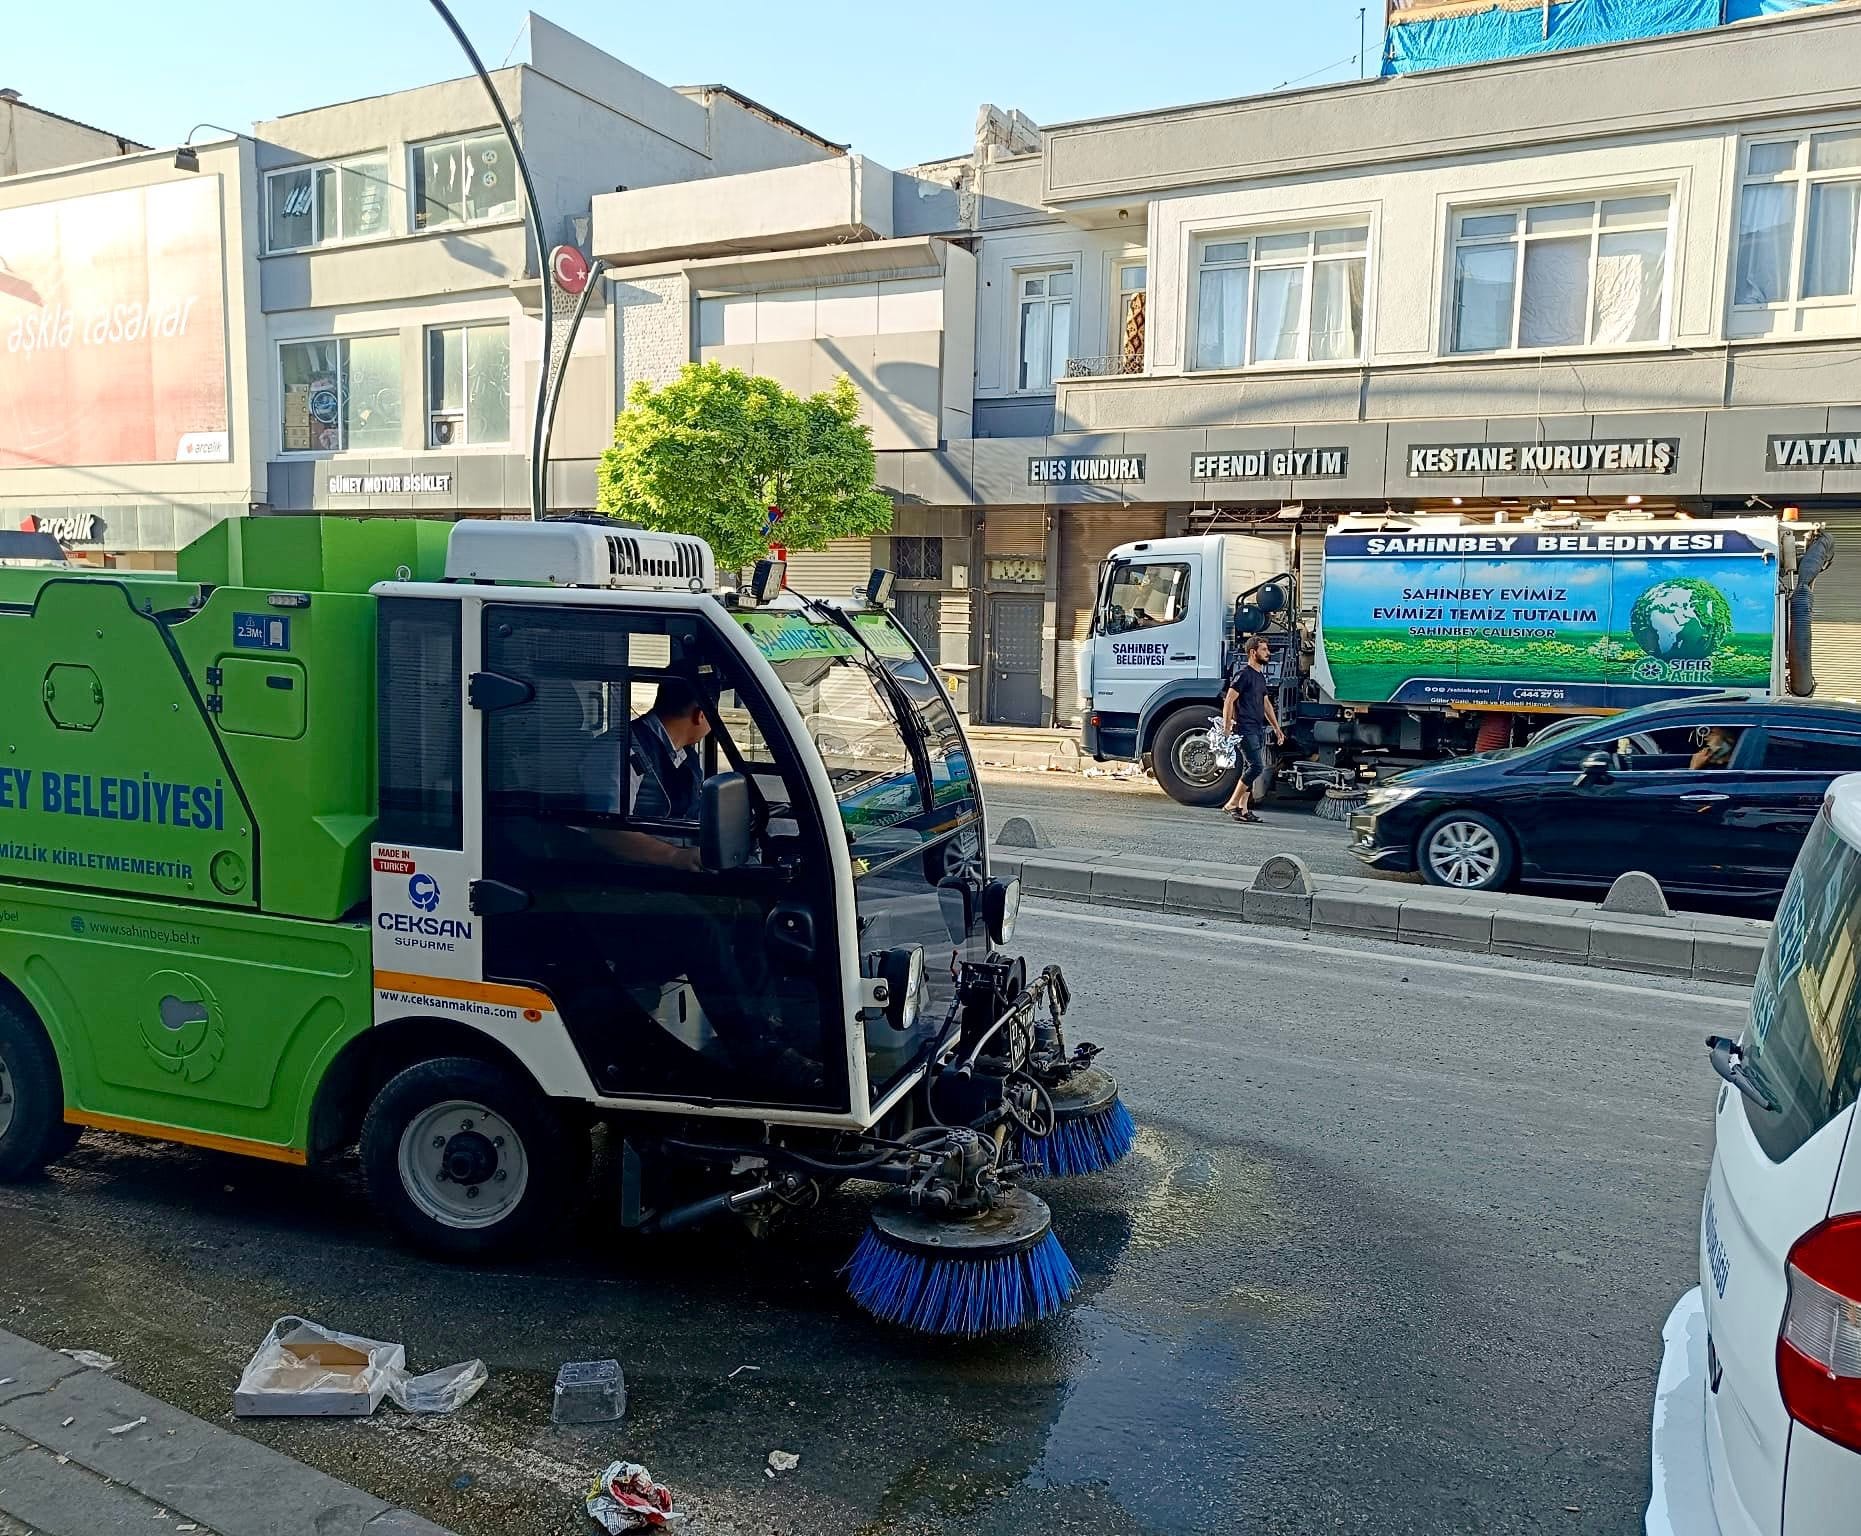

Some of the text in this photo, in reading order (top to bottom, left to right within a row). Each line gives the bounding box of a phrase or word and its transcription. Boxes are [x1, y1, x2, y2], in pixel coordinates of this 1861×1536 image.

[1194, 448, 1342, 477] EFENDİ GİYİM
[1411, 439, 1670, 473] KESTANE KURUYEMİŞ
[1774, 438, 1861, 465] VATAN
[1031, 458, 1140, 481] ENES KUNDURA
[329, 472, 450, 493] GÜNEY MOTOR BİSİKLET
[1500, 585, 1567, 601] EVİMİZ
[1449, 605, 1506, 621] TEMİZ
[1512, 608, 1597, 622] TUTALIM
[1670, 659, 1712, 671] SIFIR
[1520, 690, 1539, 698] 444
[42, 771, 224, 831] BELEDİYESİ
[52, 847, 193, 880] KİRLETMEMEKTİR
[378, 848, 410, 860] MADE IN
[379, 861, 409, 873] TURKEY
[89, 921, 201, 945] www.sahinbey.bel.tr
